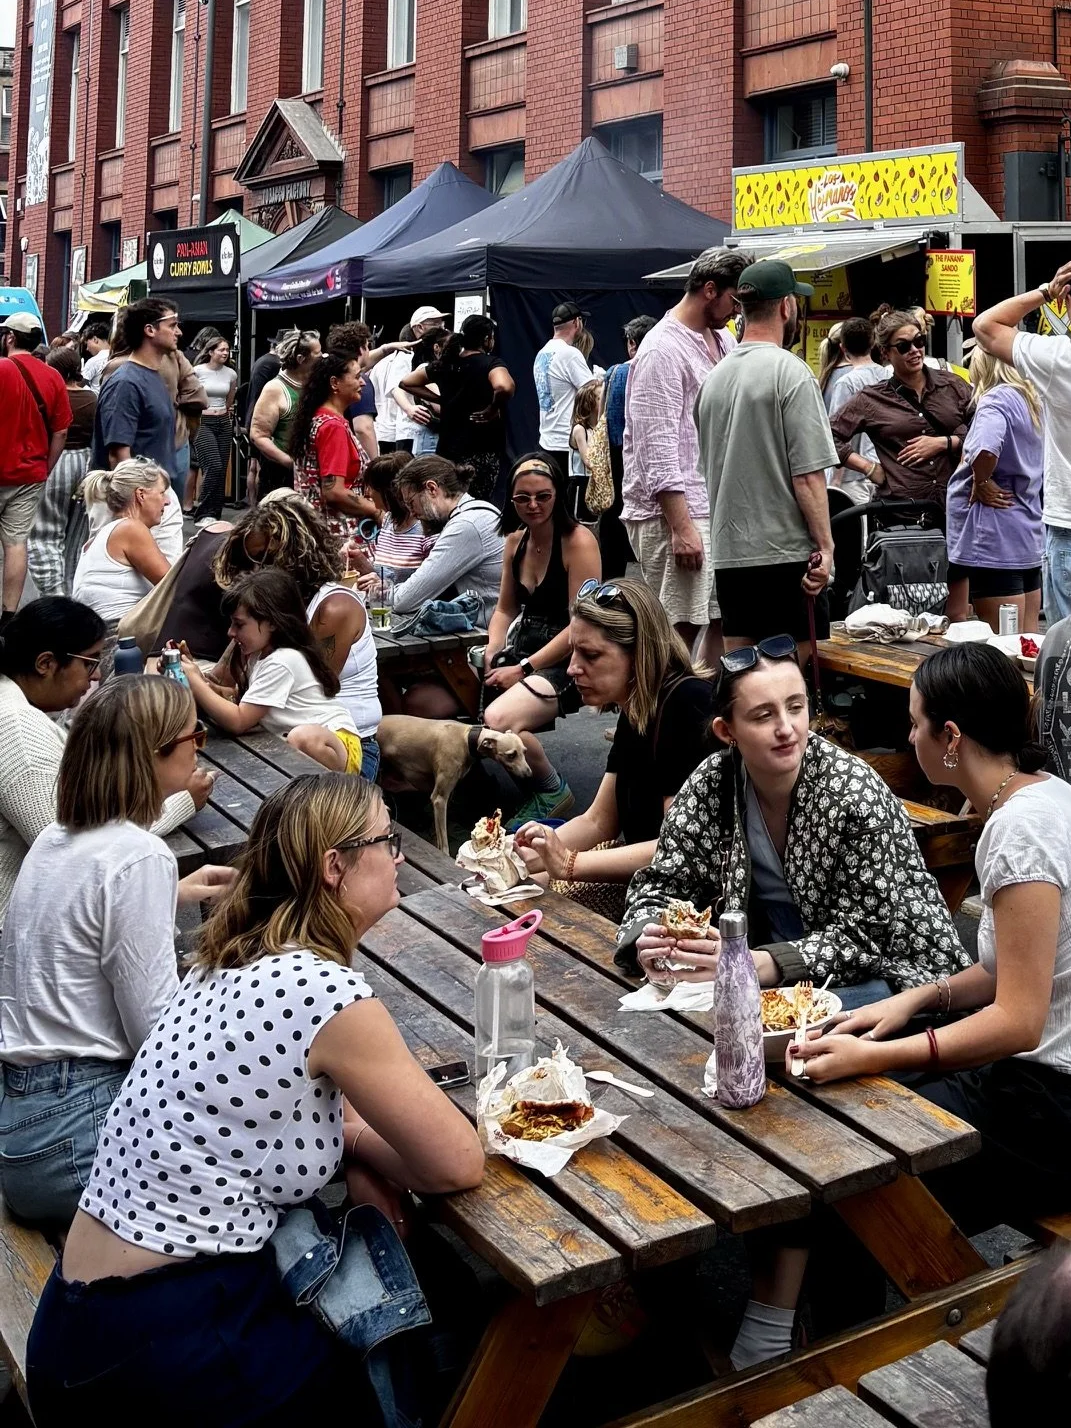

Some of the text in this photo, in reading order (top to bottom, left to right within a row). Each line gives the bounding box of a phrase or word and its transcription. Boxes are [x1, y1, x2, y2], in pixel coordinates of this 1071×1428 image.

[285, 179, 311, 202] FACTORY
[176, 240, 208, 258] PAN-ASIAN
[169, 259, 213, 277] CURRY BOWLS
[941, 264, 958, 272] SANDO
[944, 255, 964, 263] PANANG
